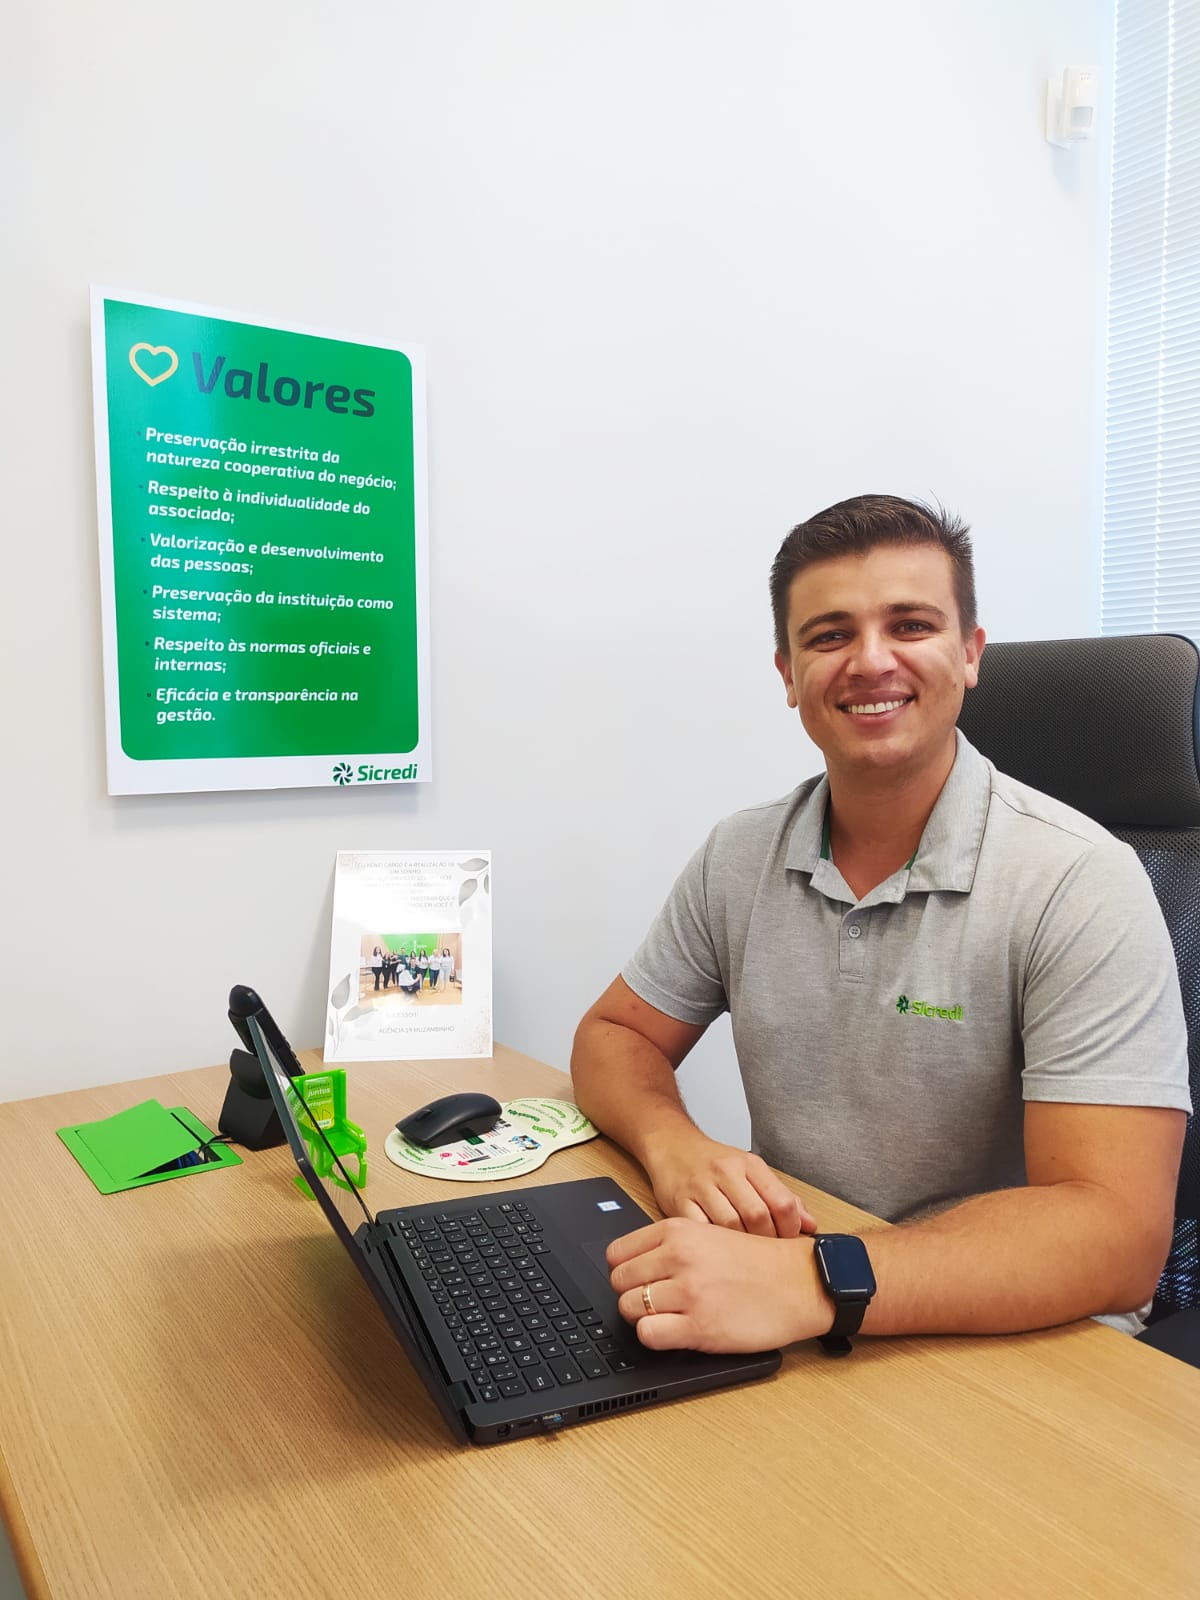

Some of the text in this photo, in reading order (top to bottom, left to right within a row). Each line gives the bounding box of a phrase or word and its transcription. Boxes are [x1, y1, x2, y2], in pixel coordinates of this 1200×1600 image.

[192, 350, 376, 418] Valores
[145, 427, 340, 464] Preservação irrestrita da
[146, 450, 397, 491] natureza cooperativa do negócio;
[148, 480, 370, 515] Respeito à individualidade do
[149, 503, 235, 524] associado;
[150, 533, 384, 563] Valorização e desenvolvimento
[150, 555, 253, 575] das pessoas;
[152, 585, 394, 611] Preservação da instituição como
[153, 607, 221, 623] sistema;
[154, 636, 371, 657] Respeito às normas oficiais e
[155, 657, 227, 673] internas;
[156, 687, 358, 704] Eficácia e transparência na
[156, 708, 216, 725] gestão.
[357, 763, 417, 781] Sicredi
[911, 1000, 963, 1021] Sicredi
[307, 1087, 331, 1097] juntos
